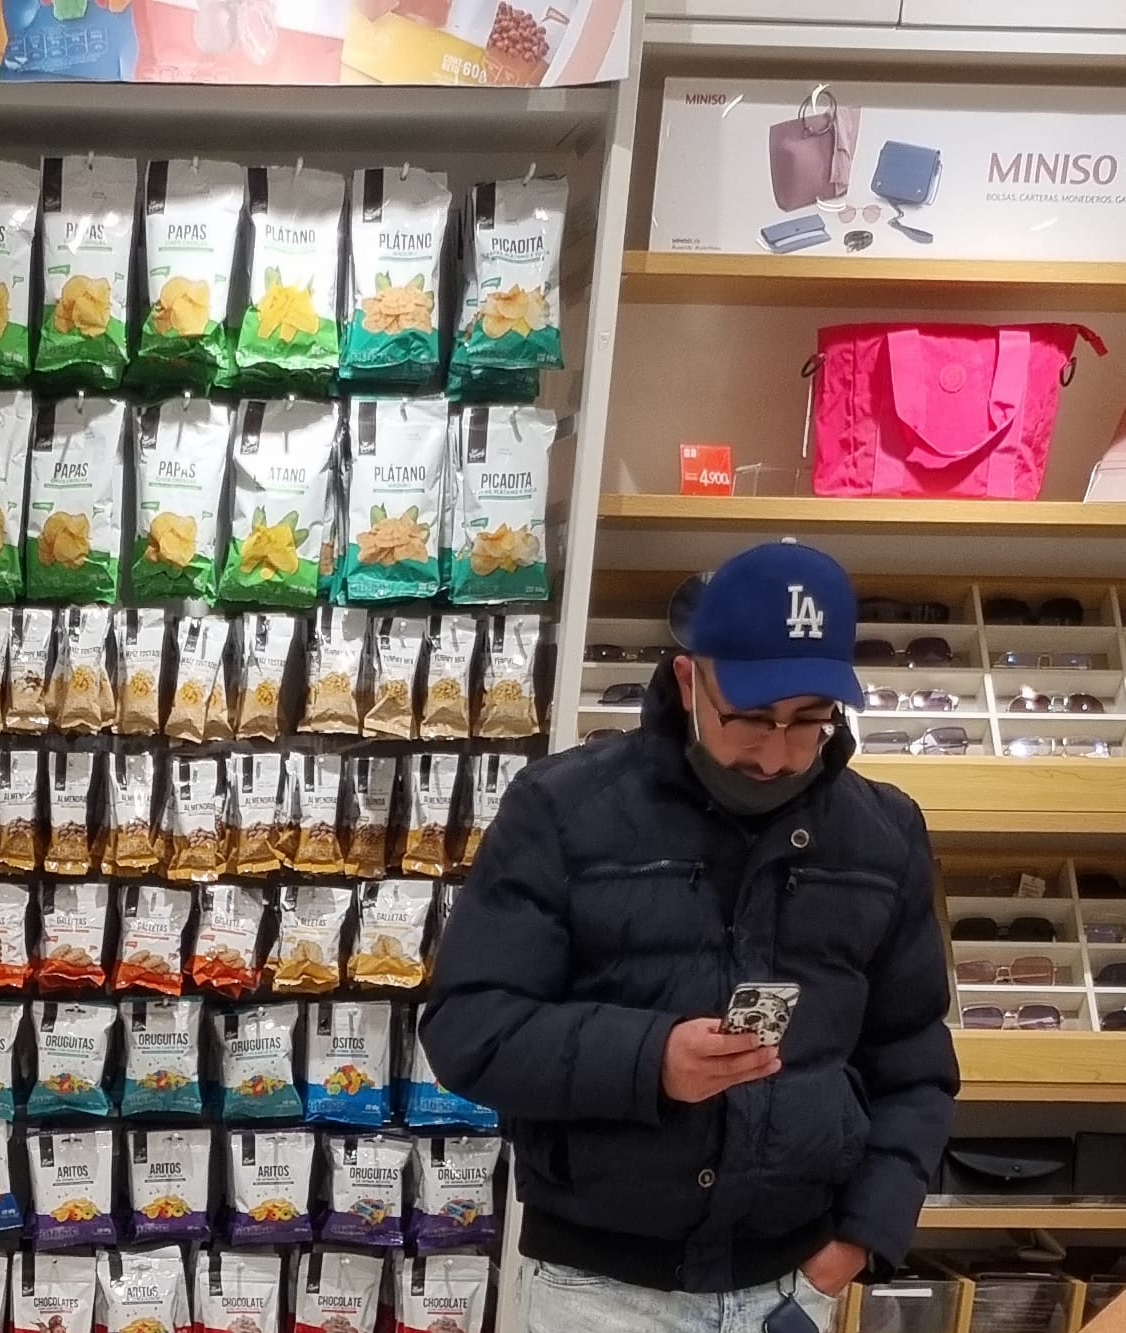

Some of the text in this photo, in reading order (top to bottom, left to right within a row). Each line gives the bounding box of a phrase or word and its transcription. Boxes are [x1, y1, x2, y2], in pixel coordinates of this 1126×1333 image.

[685, 94, 726, 105] MINISO
[987, 152, 1118, 185] MINISO
[167, 223, 207, 241] PAPAS
[265, 223, 316, 245] PLÁTANO
[378, 230, 432, 251] PLÁTANO
[491, 234, 544, 254] PICADITA
[54, 462, 89, 480] PAPAS
[158, 461, 196, 478] PAPAS
[374, 464, 425, 483] PLÁTANO
[480, 472, 532, 489] PICADITA
[786, 585, 823, 638] LA
[377, 912, 408, 922] GALLETAS
[45, 1035, 95, 1050] ORUGUITAS
[138, 1033, 189, 1046] ORUGUITAS
[231, 1037, 282, 1051] ORUGUITAS
[332, 1037, 365, 1050] OSITOS
[57, 1165, 89, 1178] ARITOS
[150, 1162, 182, 1175] ARITOS
[258, 1165, 290, 1177] ARITOS
[350, 1167, 399, 1181] ORUGUITAS
[438, 1167, 487, 1181] ORUGUITAS
[126, 1285, 159, 1298] ARITOS
[33, 1297, 79, 1309] CHOCOLATES
[221, 1297, 264, 1309] CHOCOLATE
[317, 1295, 363, 1308] CHOCOLATE
[423, 1297, 468, 1309] CHOCOLATE
